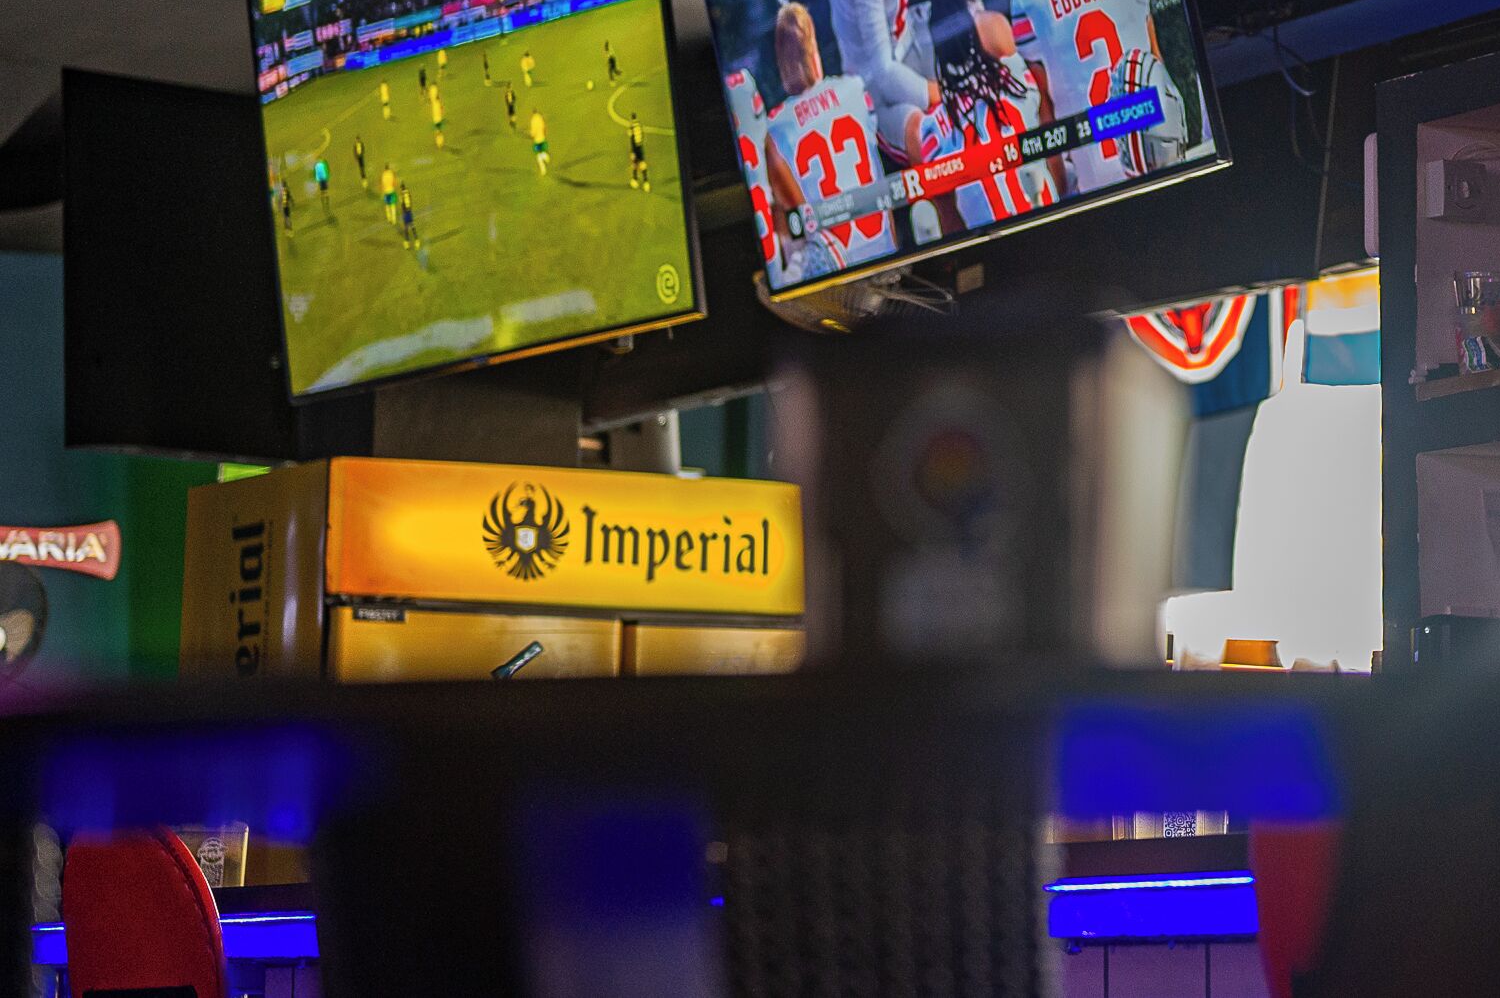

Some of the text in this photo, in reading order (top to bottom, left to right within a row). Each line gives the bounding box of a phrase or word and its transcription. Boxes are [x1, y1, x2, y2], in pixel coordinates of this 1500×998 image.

[793, 87, 842, 127] BROWN
[1102, 99, 1156, 129] CBS SPORTS
[1022, 135, 1043, 156] 4TH
[1044, 125, 1069, 150] 2:07
[923, 157, 966, 182] RUTGERS
[1003, 143, 1019, 163] 16
[903, 169, 925, 199] R
[581, 504, 771, 583] Imperial
